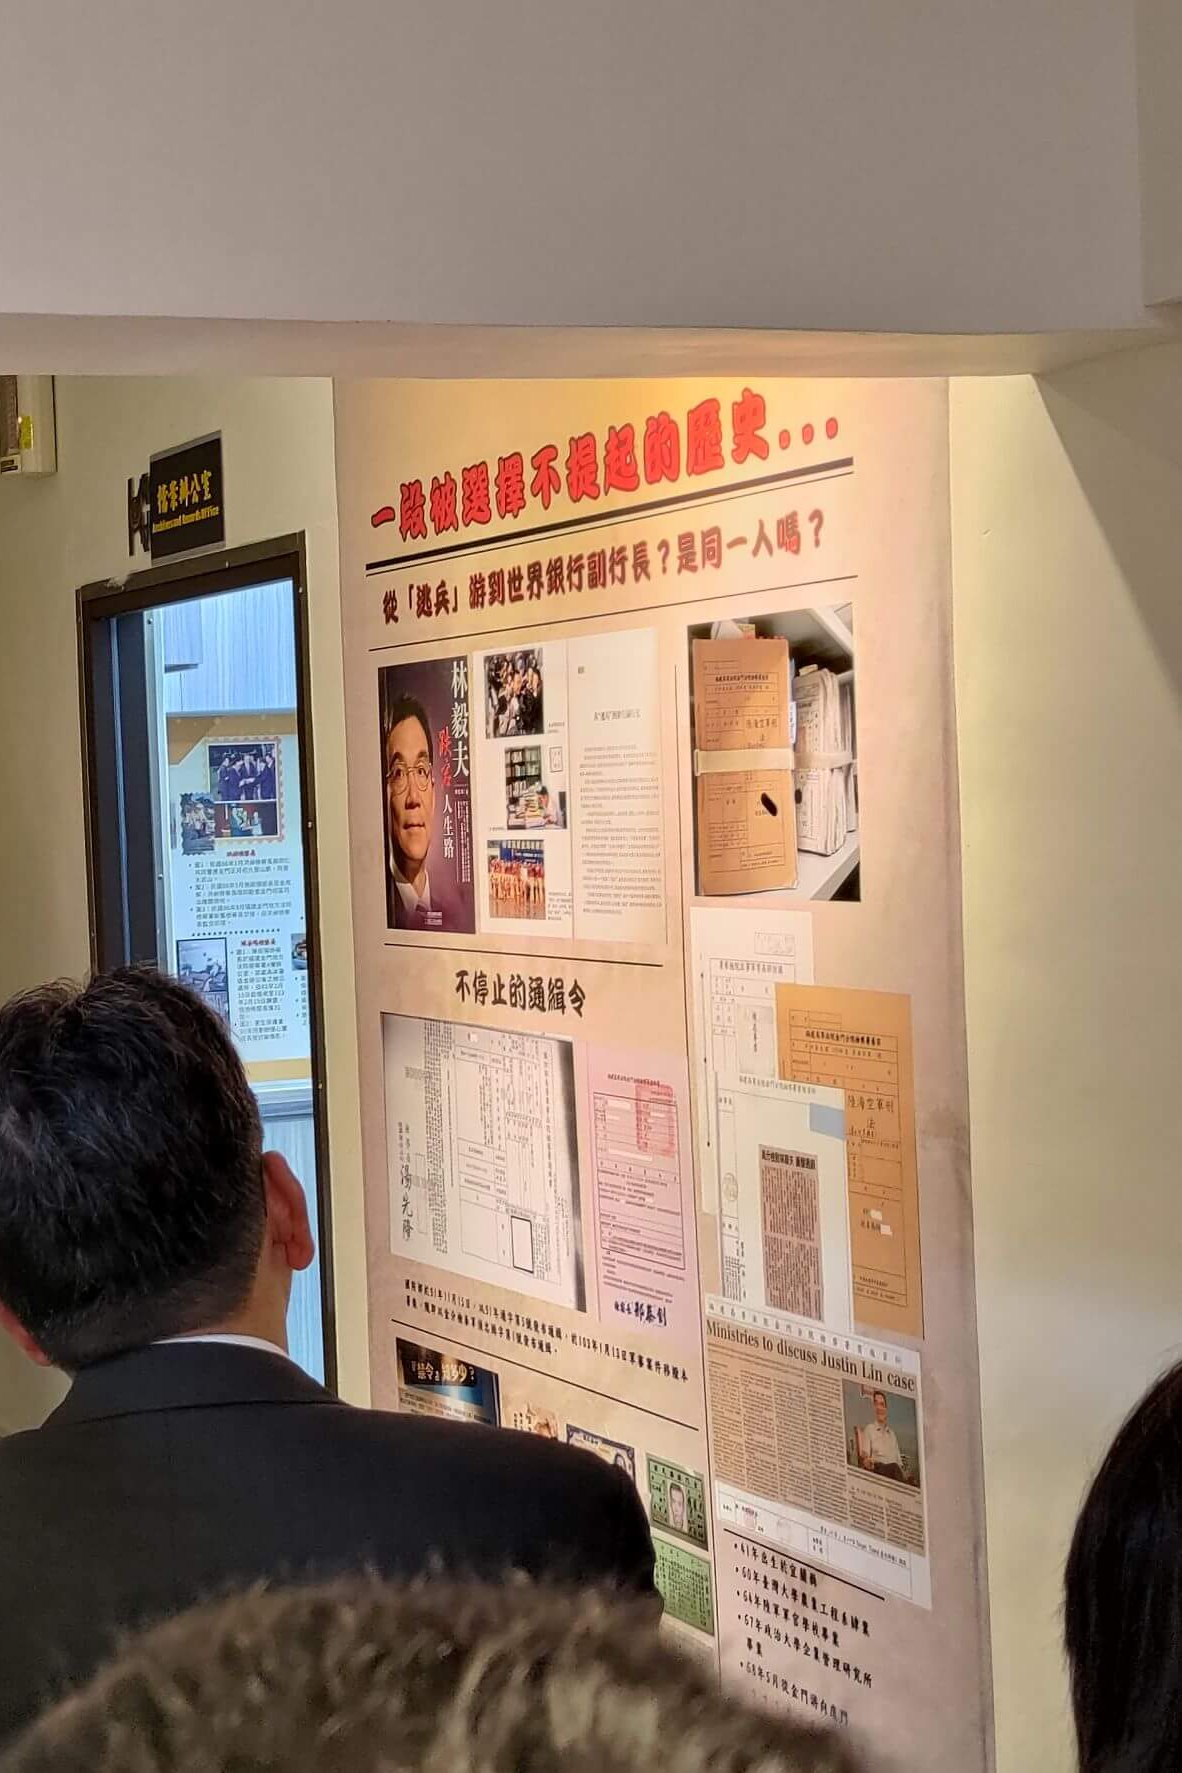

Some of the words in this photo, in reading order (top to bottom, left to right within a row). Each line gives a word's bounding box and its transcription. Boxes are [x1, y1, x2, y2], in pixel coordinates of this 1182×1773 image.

[450, 660, 470, 778] 林毅夫
[455, 969, 586, 1018] 不停止的通緝令
[706, 1319, 760, 1348] Ministries
[762, 1334, 774, 1352] to
[776, 1338, 818, 1364] discuss
[820, 1350, 858, 1377] Justin
[862, 1360, 884, 1383] Lin
[887, 1372, 916, 1392] case
